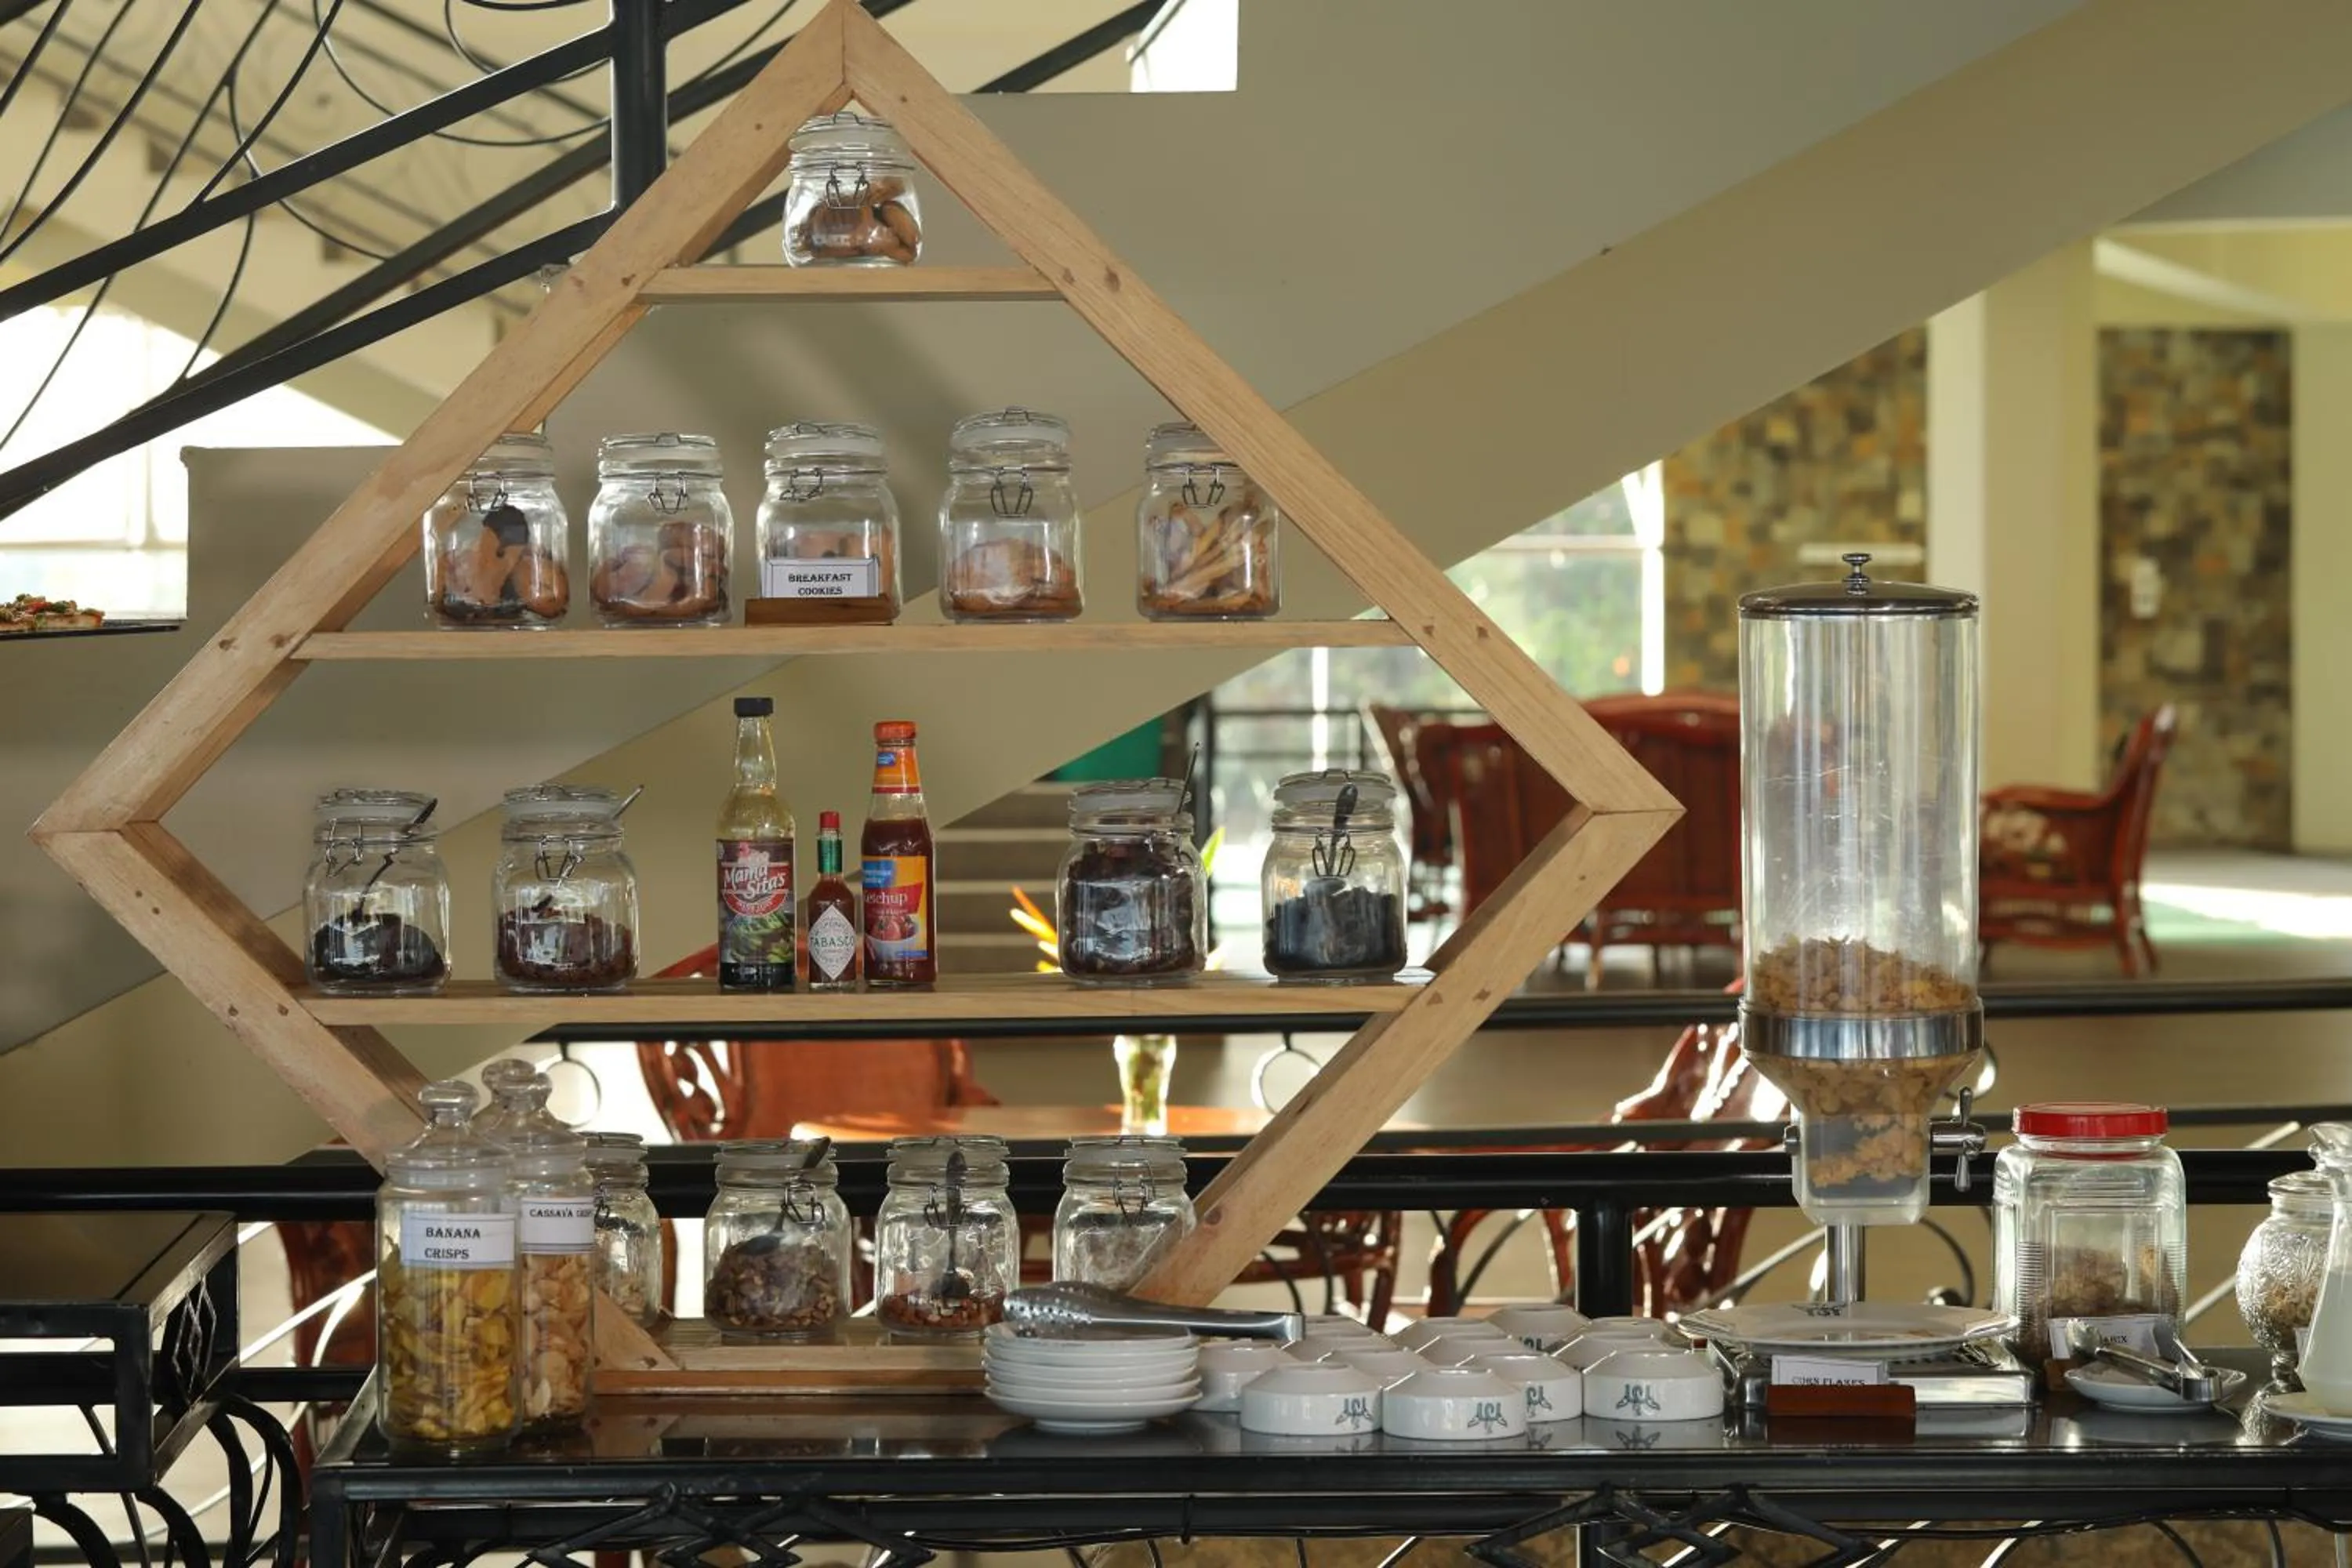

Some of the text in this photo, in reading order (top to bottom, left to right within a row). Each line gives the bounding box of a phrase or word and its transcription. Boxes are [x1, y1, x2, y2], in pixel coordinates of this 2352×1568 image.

[788, 573, 853, 583] BREAKFAST
[797, 586, 843, 596] COOKIES
[724, 865, 768, 891] Mama
[744, 873, 786, 899] Sita's
[810, 936, 854, 948] TABASCO
[529, 1207, 574, 1218] CASSAVA
[426, 1227, 481, 1239] BANANA
[424, 1247, 470, 1259] CRISPS
